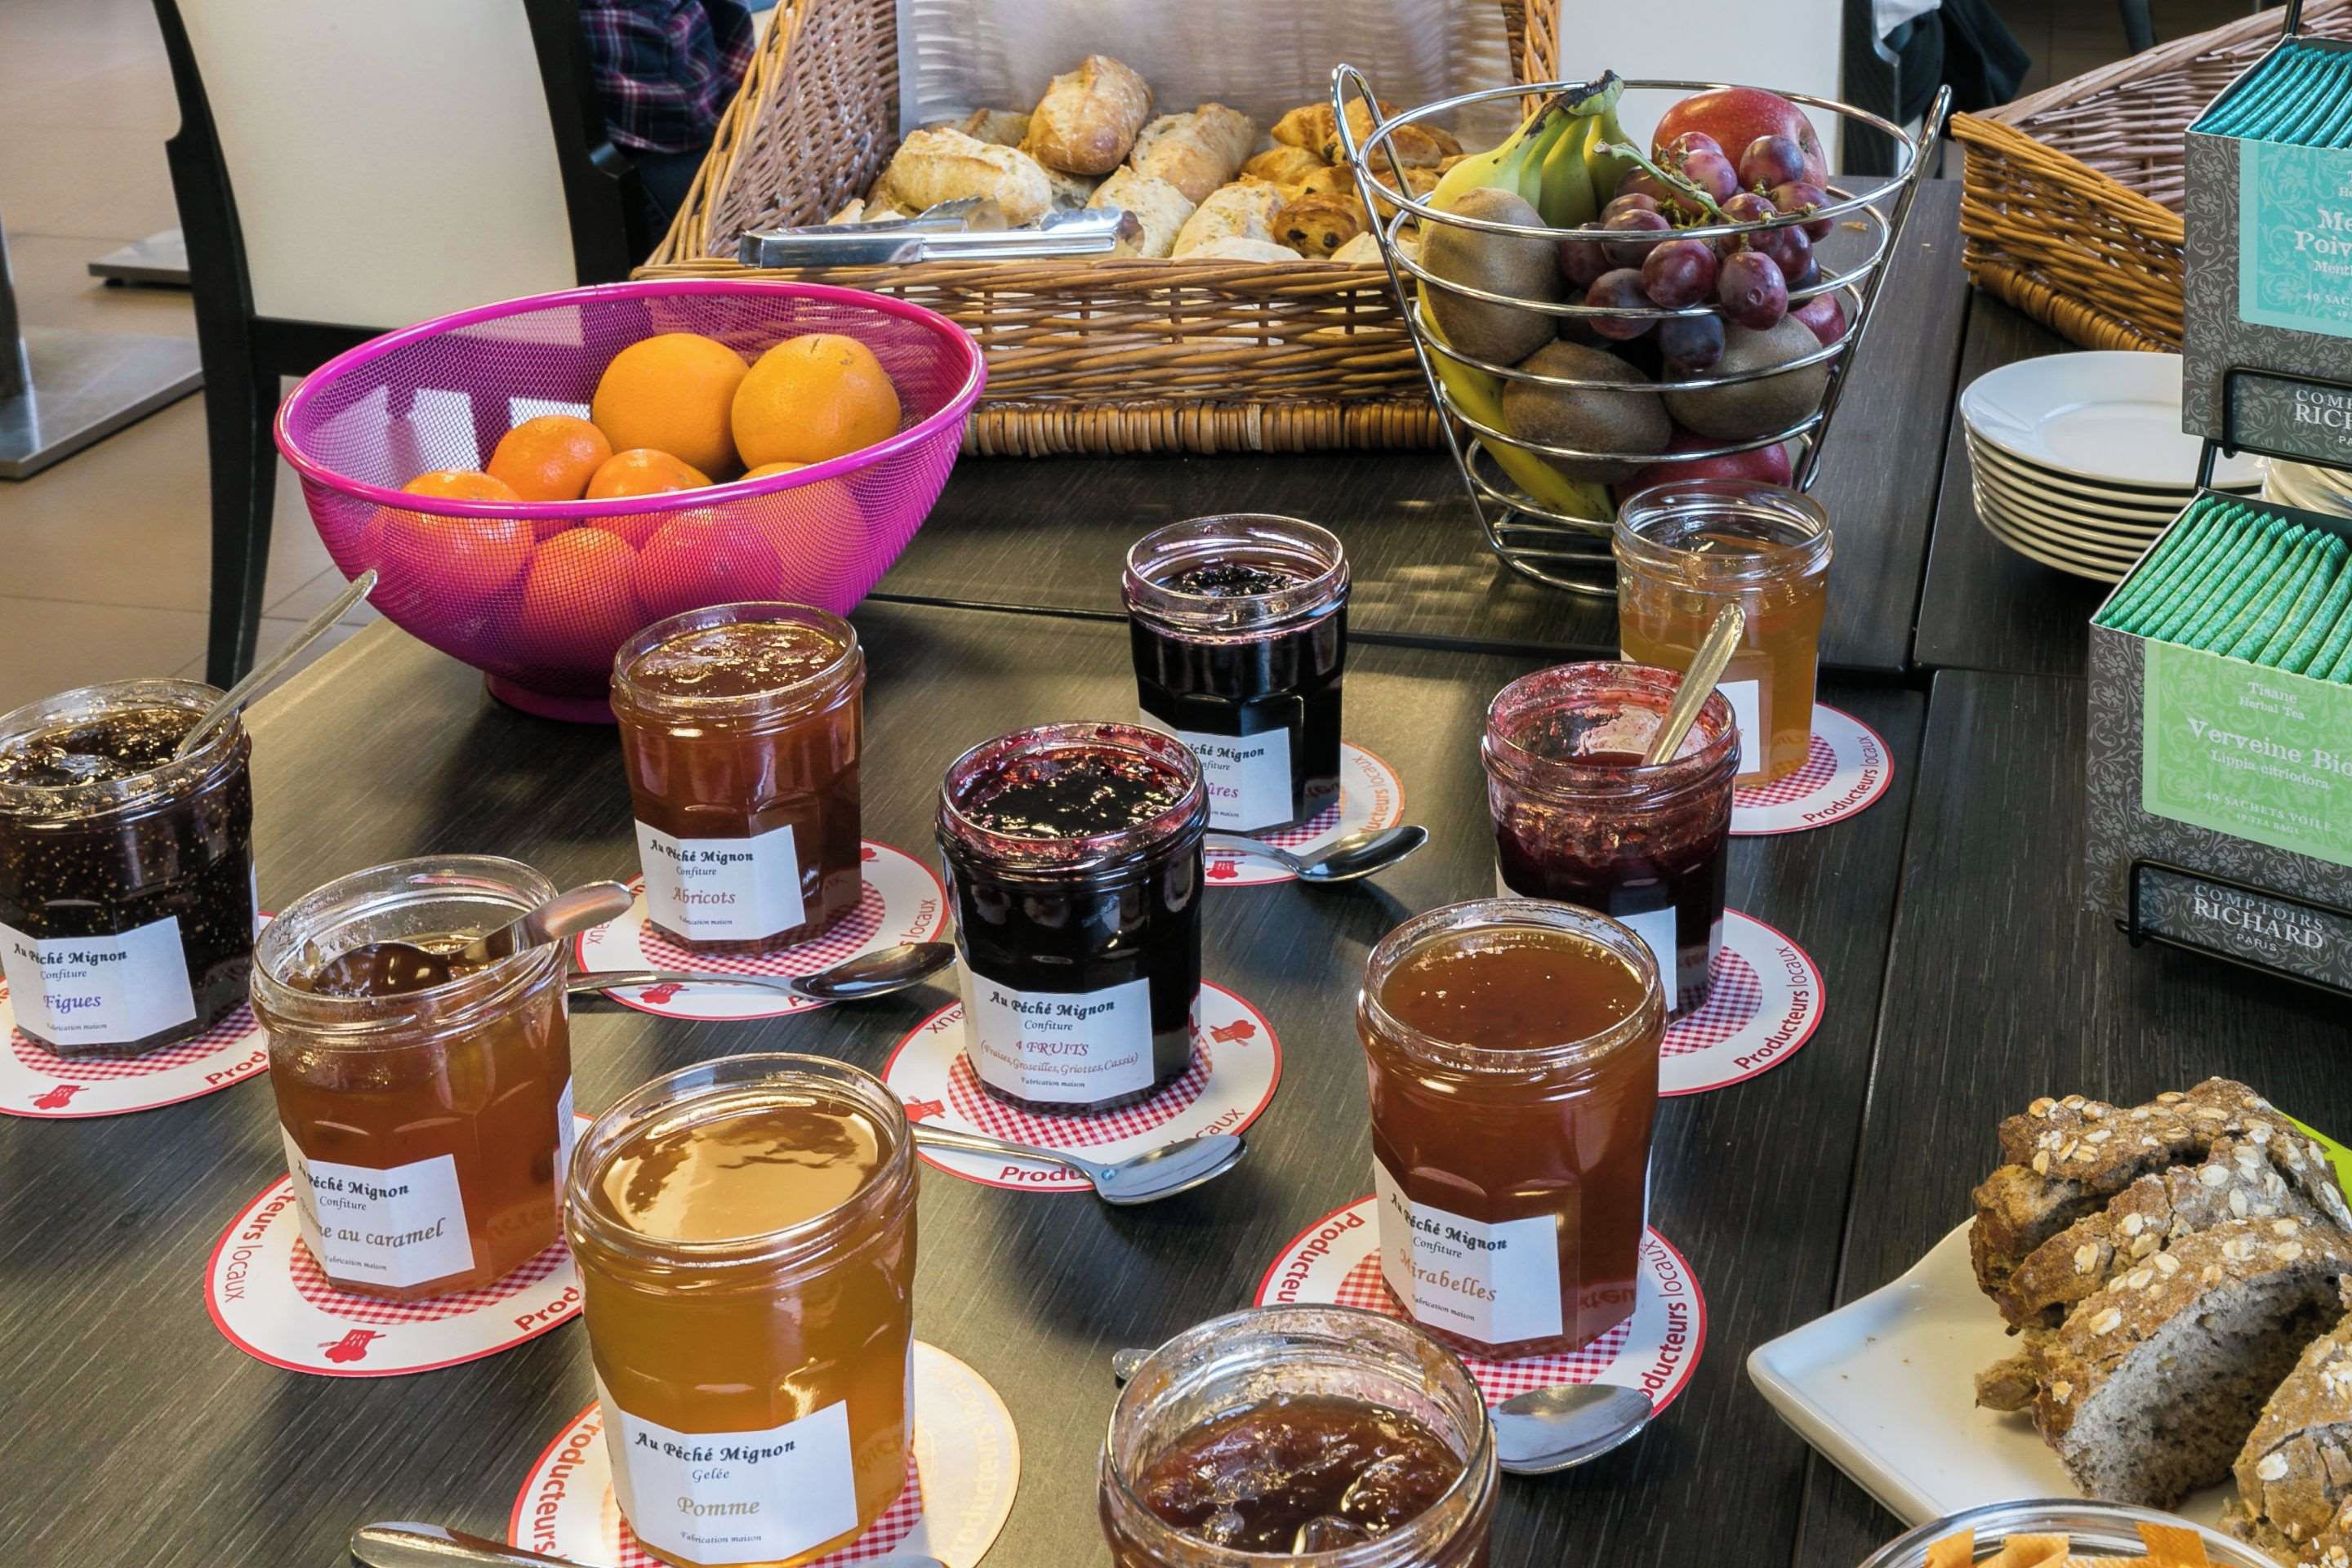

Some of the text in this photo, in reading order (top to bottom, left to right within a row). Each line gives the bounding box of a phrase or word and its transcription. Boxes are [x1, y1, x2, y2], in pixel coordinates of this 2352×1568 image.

[2325, 293, 2352, 306] SAC
[2247, 681, 2298, 704] Tisane
[2238, 696, 2278, 714] Herbal
[1217, 747, 1265, 763] Mignon
[2188, 718, 2352, 777] Verveine Bio
[1802, 735, 1879, 823] Producteurs locaux
[2211, 750, 2330, 791] Lippia citriodora
[2225, 796, 2286, 820] SACHETS
[650, 840, 664, 853] Au
[701, 850, 754, 866] Mignon
[676, 866, 717, 879] Confiture
[672, 886, 737, 904] Abricots
[900, 898, 938, 938] locaux
[2194, 884, 2323, 931] COMPTOIRS
[2194, 897, 2323, 948] RICHARD
[2237, 933, 2277, 951] PARIS
[69, 951, 127, 966] Mignon
[40, 969, 87, 982] Confiture
[43, 994, 102, 1013] Figues
[989, 991, 1116, 1020] Au Péché Mignon
[1733, 946, 1809, 1070] Producteurs locaux
[1024, 1020, 1073, 1032] Confiture
[1015, 1040, 1089, 1056] 4 FRUITS
[348, 1181, 410, 1200] Mignon
[319, 1196, 367, 1211] Confiture
[337, 1217, 447, 1248] au caramel
[1446, 1227, 1508, 1251] Mignon
[1413, 1236, 1463, 1258] Confiture
[225, 1245, 264, 1303] locaux
[1400, 1249, 1498, 1302] Mirabelles
[1645, 1240, 1685, 1297] locaux
[635, 1432, 796, 1463] Au Péché Mignon
[692, 1468, 731, 1483] Gelée
[677, 1497, 760, 1517] Pomme
